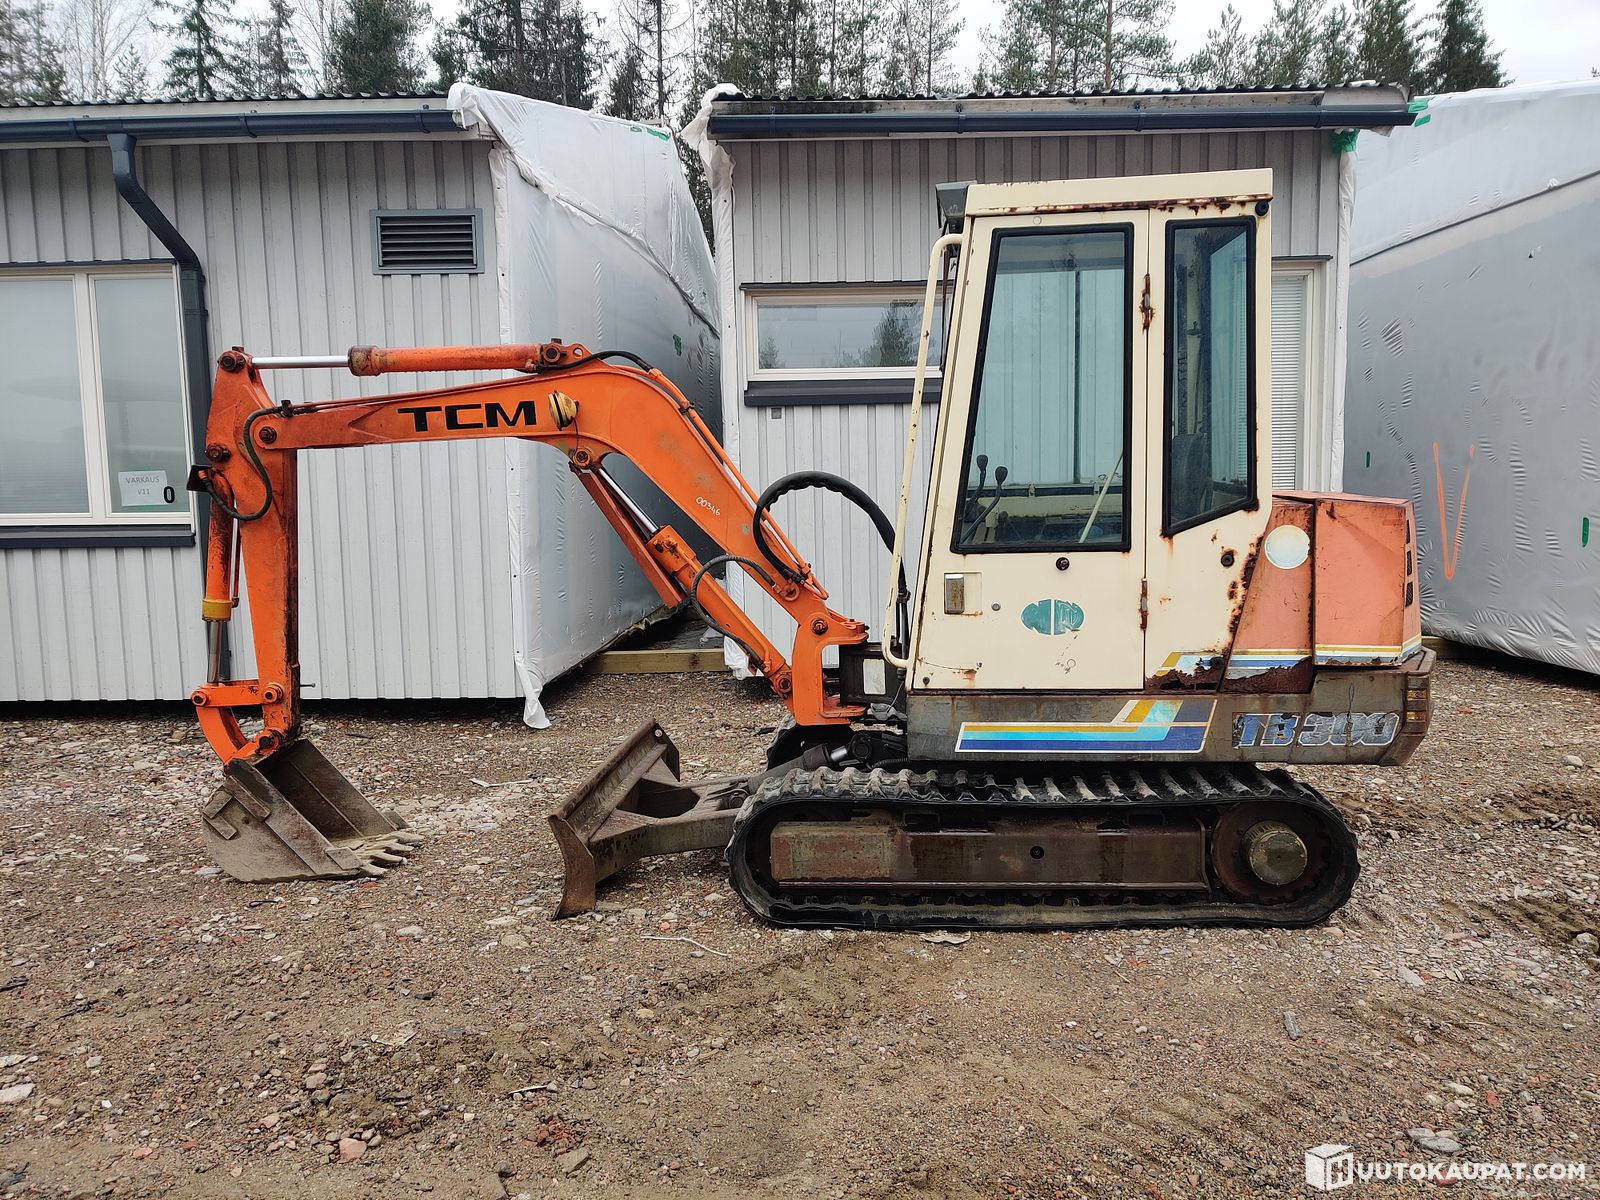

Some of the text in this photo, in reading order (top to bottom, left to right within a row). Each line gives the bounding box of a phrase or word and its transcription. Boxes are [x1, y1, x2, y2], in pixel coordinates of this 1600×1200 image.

[397, 400, 537, 432] TCM
[126, 475, 160, 484] VARKAUS
[695, 496, 721, 516] 00346
